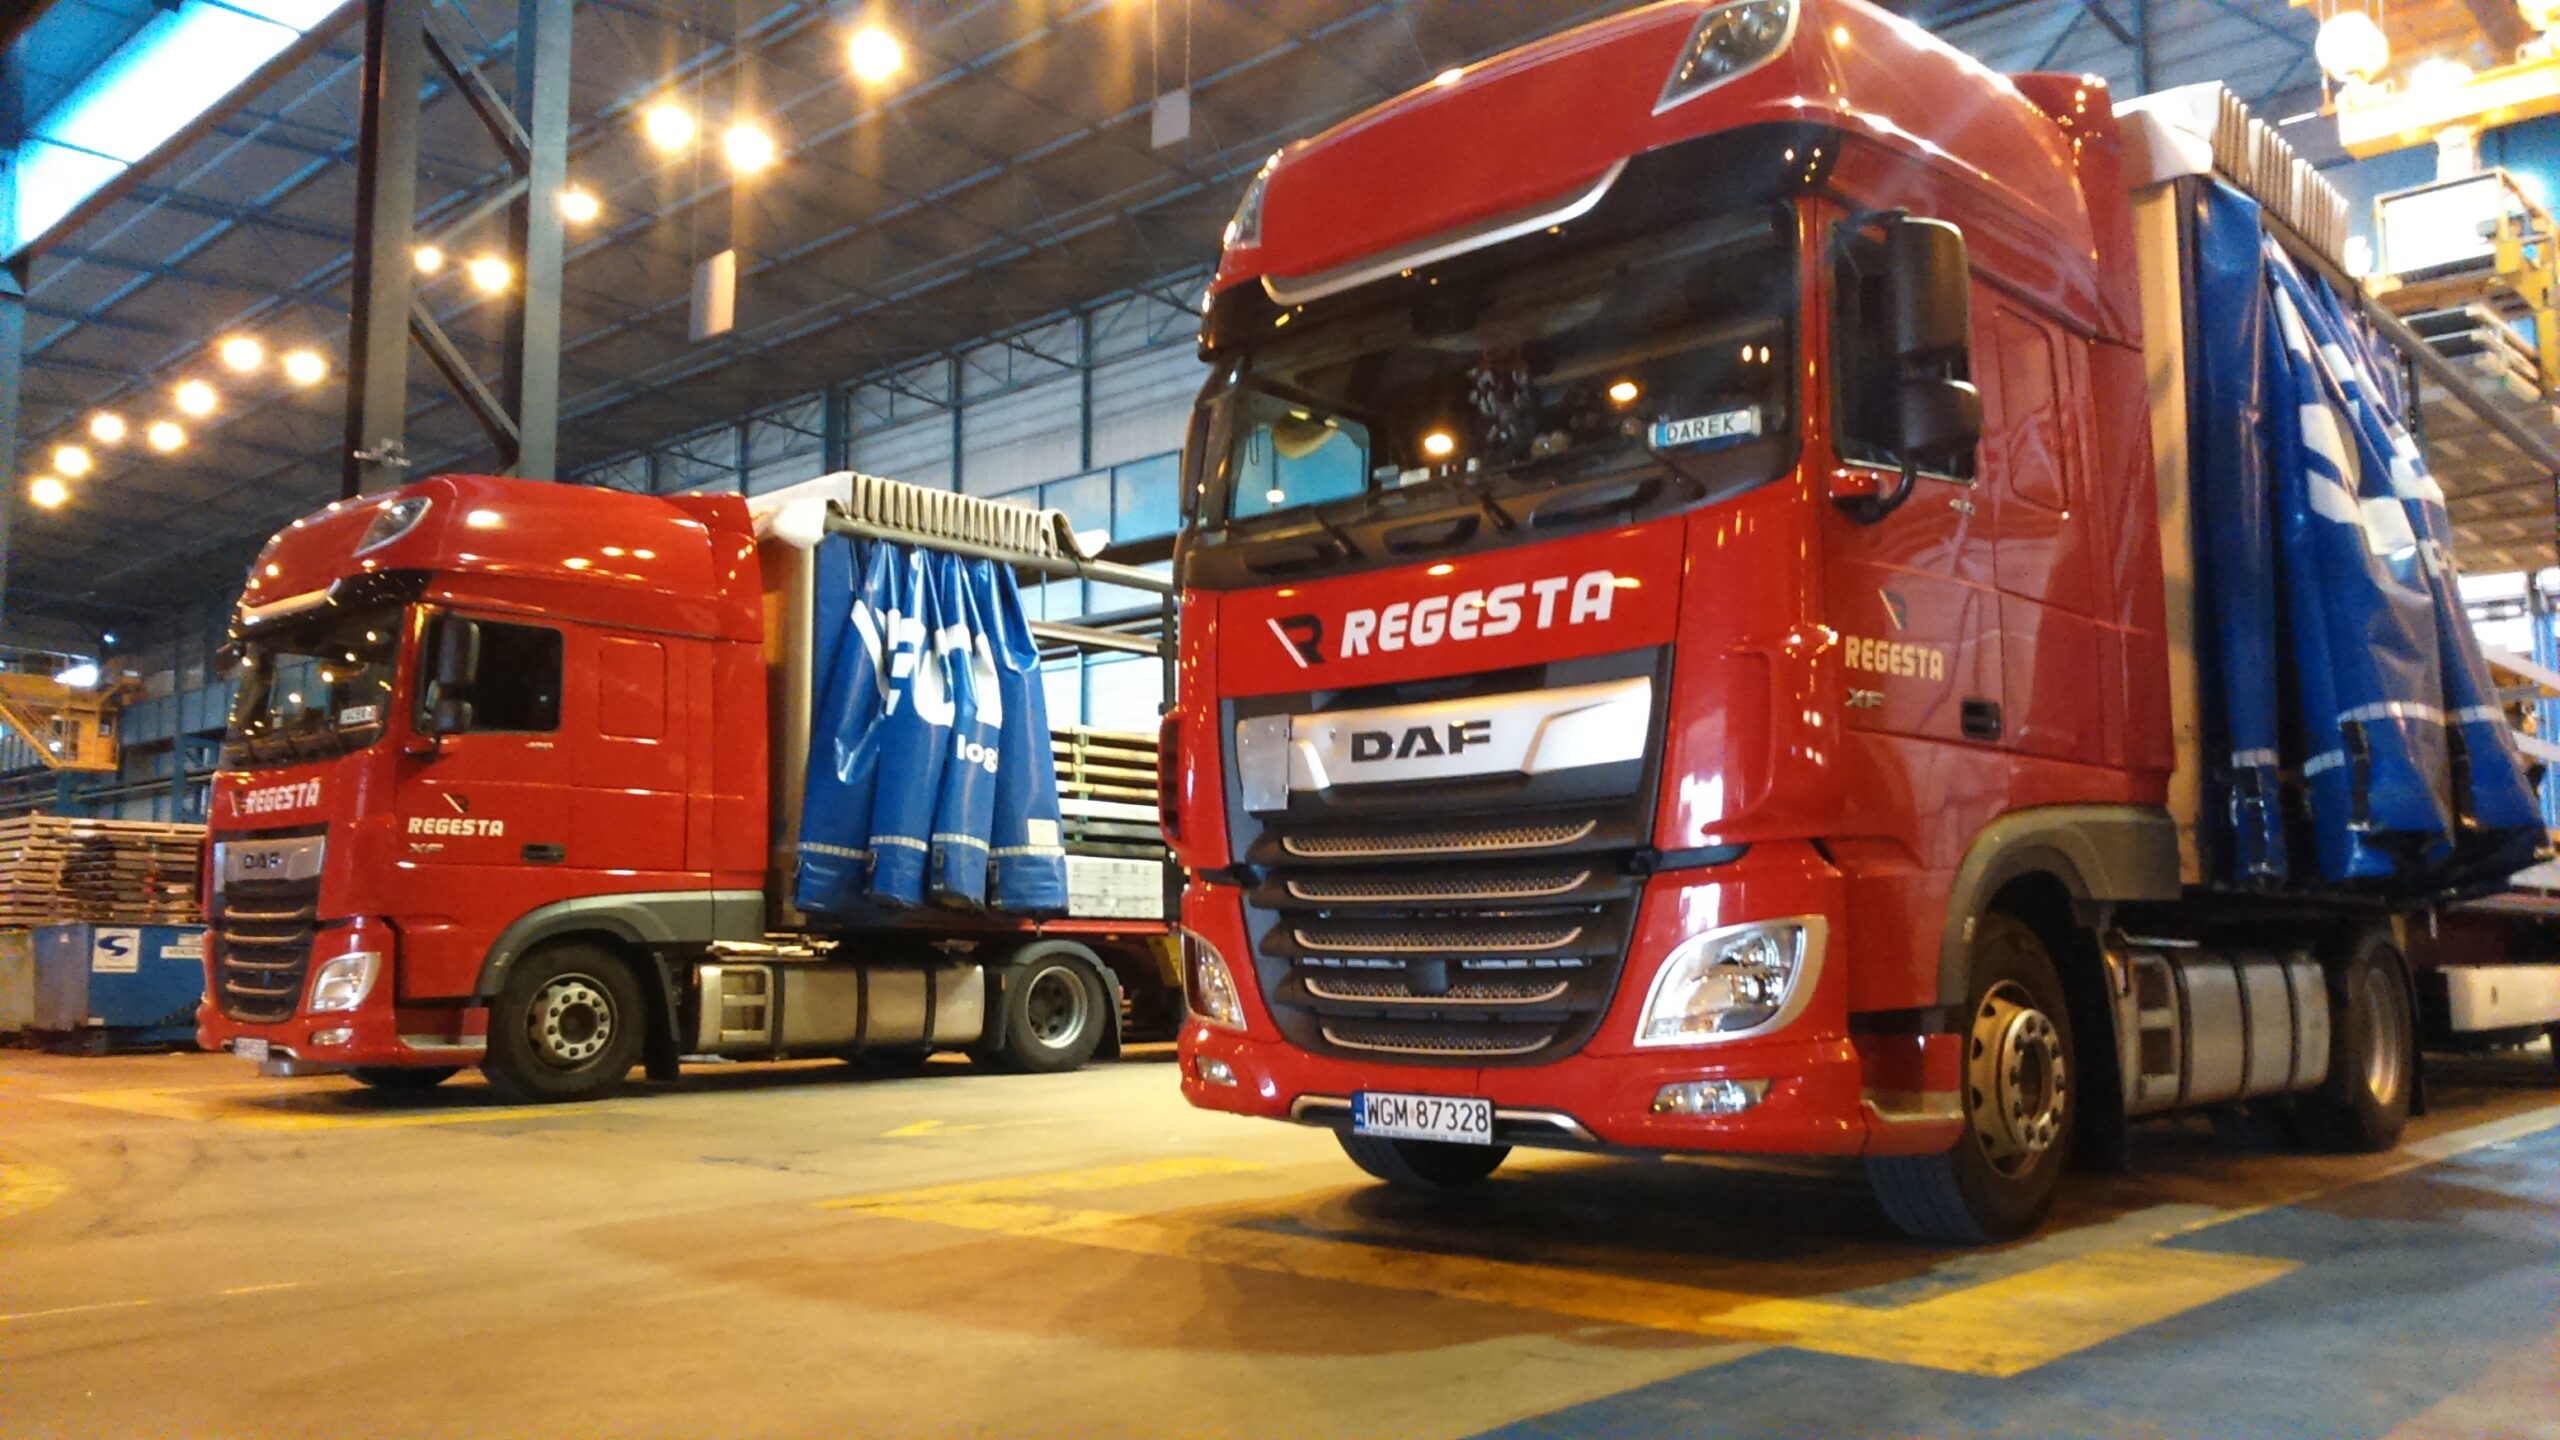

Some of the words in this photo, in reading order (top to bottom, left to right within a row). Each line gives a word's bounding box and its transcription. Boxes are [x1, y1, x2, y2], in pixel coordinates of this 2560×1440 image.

[1667, 413, 1735, 441] DAREK
[1340, 569, 1616, 659] REGESTA
[1844, 634, 1944, 681] REGESTA
[1844, 687, 1885, 709] XF
[1351, 719, 1492, 763] DAF
[244, 781, 321, 814] REGESTA
[407, 816, 504, 837] REGESTA
[1366, 1096, 1409, 1127] WGM
[1415, 1100, 1489, 1133] 87328
